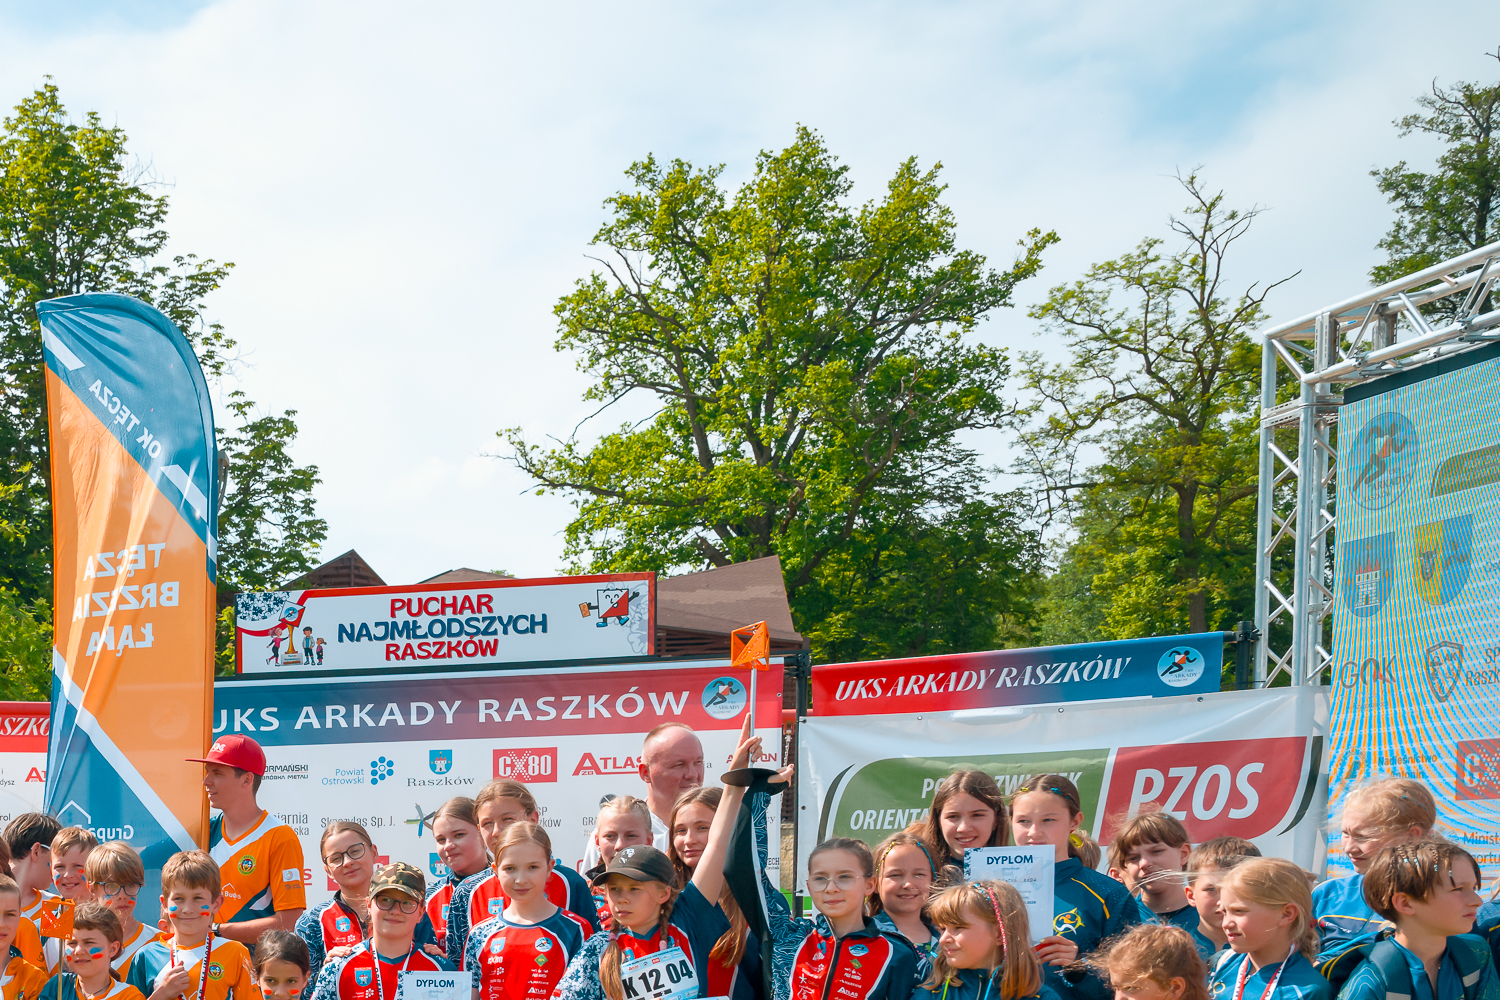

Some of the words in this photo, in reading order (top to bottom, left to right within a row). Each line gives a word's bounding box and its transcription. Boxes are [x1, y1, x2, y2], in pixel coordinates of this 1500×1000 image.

[390, 593, 494, 618] PUCHAR
[337, 613, 548, 643] NAJMŁODSZYCH
[385, 634, 499, 661] RASZKÓW
[835, 678, 888, 701] UKS
[886, 668, 997, 697] ARKADY
[995, 654, 1132, 689] RASZKÓW
[213, 707, 280, 733] UKS
[294, 700, 462, 730] ARKADY
[478, 686, 690, 723] RASZKÓW
[336, 768, 364, 776] Powiat
[498, 751, 552, 781] CX80
[322, 776, 364, 785] Ostrowski
[407, 776, 475, 787] Raszków
[1127, 762, 1265, 821] PZOS
[986, 854, 1034, 865] DYPLOM
[416, 979, 455, 988] DYPLOM
[622, 977, 639, 999] K
[638, 968, 665, 993] 12
[665, 960, 693, 984] 04
